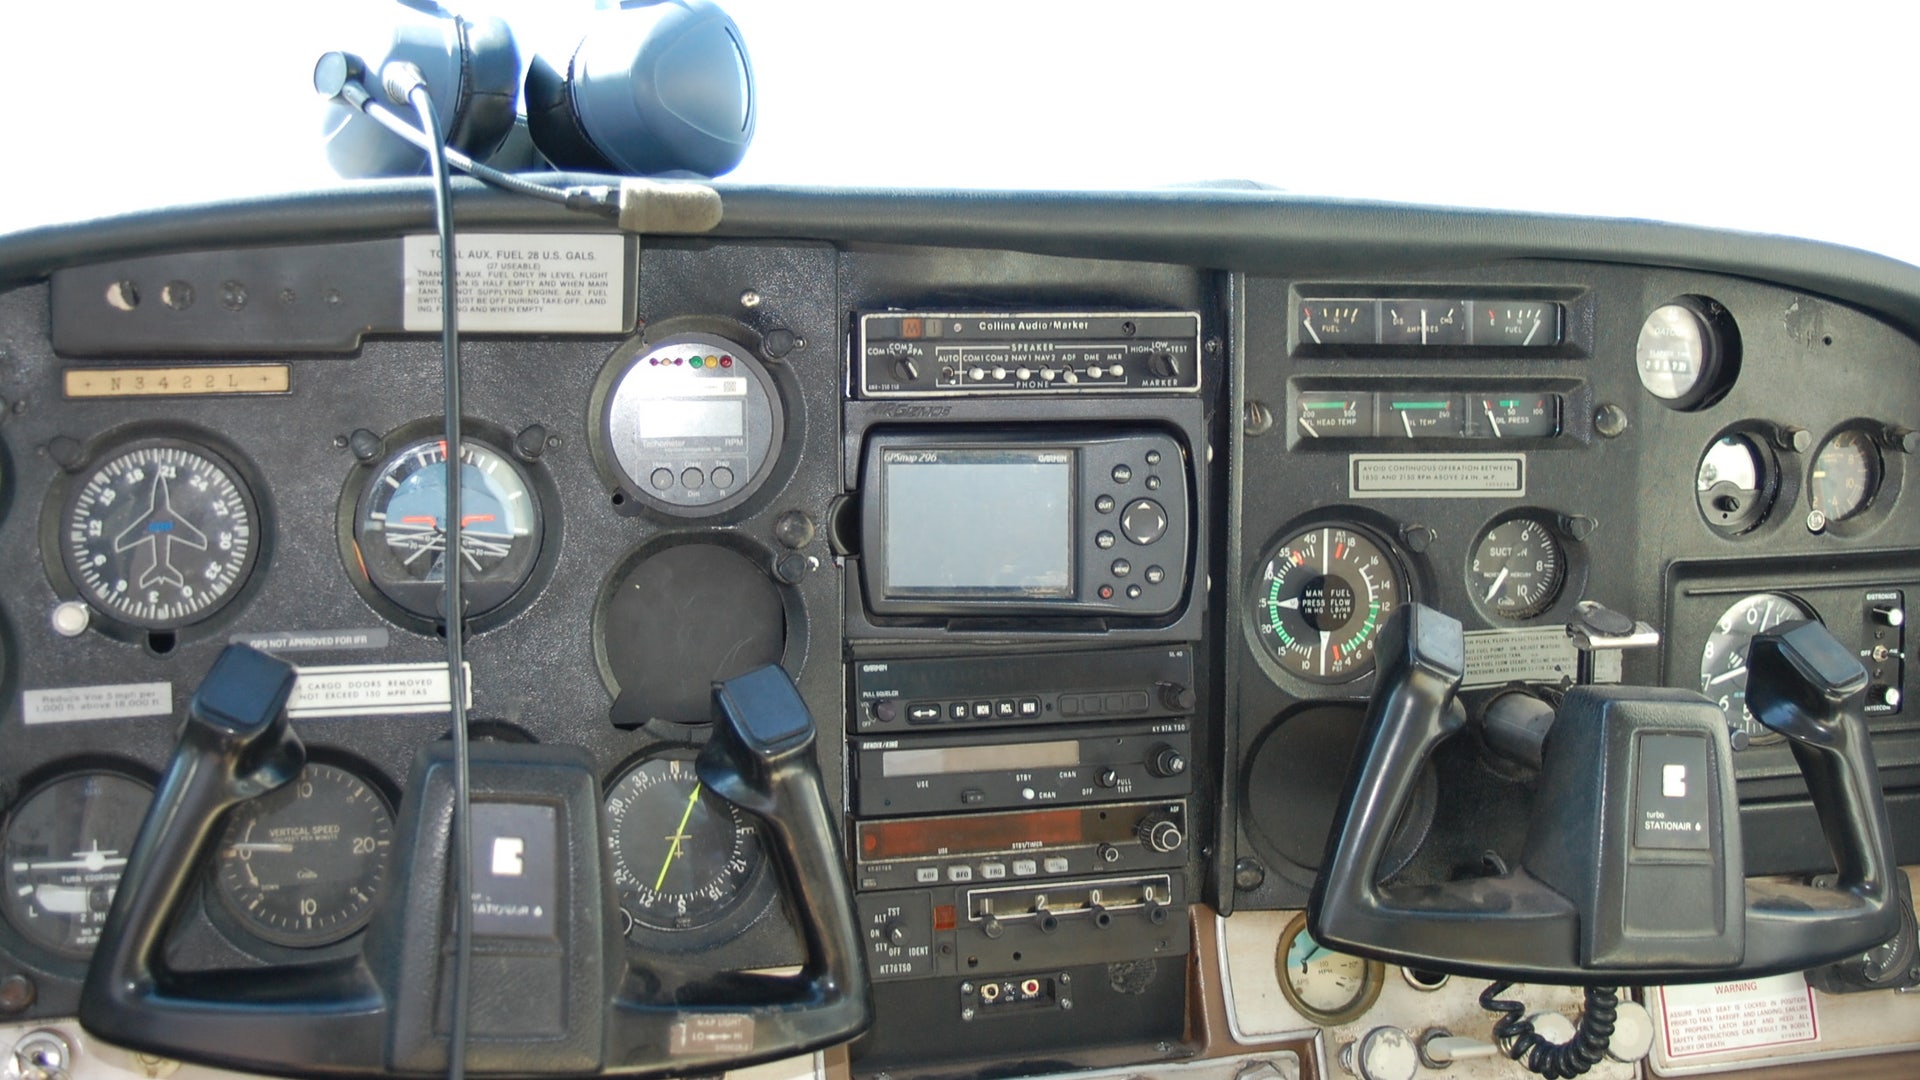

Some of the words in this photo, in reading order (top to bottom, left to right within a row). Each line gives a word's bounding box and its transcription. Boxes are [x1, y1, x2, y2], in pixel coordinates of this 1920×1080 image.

[430, 250, 463, 259] TOL
[468, 250, 492, 259] AUX.
[497, 250, 524, 259] FUEL
[528, 251, 540, 259] 28
[543, 251, 562, 260] U.S.
[566, 251, 596, 260] GALS.
[487, 262, 498, 270] (27
[501, 262, 540, 270] USEABLE)
[979, 320, 1015, 331] Collins
[1142, 379, 1178, 387] MARKER
[725, 438, 744, 446] RPM
[918, 453, 937, 462] 296
[126, 468, 144, 484] 18
[161, 466, 176, 478] 21
[189, 474, 208, 492] 24
[100, 488, 116, 506] 15
[212, 500, 228, 516] 27
[89, 519, 102, 537] 12
[220, 532, 232, 549] 30
[1304, 534, 1316, 544] 40
[1488, 531, 1496, 541] 4
[1522, 530, 1529, 541] 6
[1347, 538, 1356, 547] 18
[1279, 548, 1290, 558] 35
[1490, 548, 1527, 556] SUCTN
[1370, 556, 1378, 566] 16
[1473, 560, 1479, 571] 2
[1536, 561, 1543, 571] 8
[205, 561, 222, 580] 33
[1381, 580, 1390, 590] 14
[1518, 585, 1527, 596] 10
[1382, 602, 1390, 611] 12
[1746, 608, 1758, 625] 0
[1721, 619, 1731, 635] 9
[251, 640, 267, 649] GPS
[269, 639, 287, 648] NOT
[289, 637, 333, 647] APPROVED
[335, 636, 352, 645] FOR
[354, 635, 367, 644] IFR
[1367, 640, 1373, 649] 8
[1278, 647, 1286, 656] 15
[1356, 650, 1362, 659] 6
[1705, 642, 1714, 658] 8
[1302, 660, 1310, 670] 10
[1345, 656, 1351, 665] 4
[308, 682, 342, 690] CARGO
[348, 681, 382, 689] DOORS
[388, 679, 432, 687] REMOVED
[300, 692, 319, 700] NOT
[326, 690, 359, 699] EXCEED
[412, 688, 427, 696] IAS
[1001, 704, 1012, 713] RCL
[1023, 702, 1035, 712] MEM
[1719, 696, 1730, 712] 6
[977, 704, 990, 715] MON
[670, 761, 680, 774] N
[632, 771, 648, 788] 33
[1016, 773, 1032, 782] STBY
[1059, 771, 1076, 779] CHAN
[1039, 791, 1056, 799] CHAN
[609, 798, 623, 815] 30
[1646, 811, 1664, 819] turbo
[269, 827, 310, 836] VERTICAL
[312, 825, 340, 833] SPEED
[1645, 821, 1691, 831] STATIONAIR
[1695, 822, 1701, 831] 6
[353, 837, 375, 854] 20
[29, 906, 38, 917] L
[301, 898, 317, 915] 10
[888, 908, 900, 916] TST
[874, 914, 886, 923] ALT
[889, 948, 901, 956] OFF
[909, 947, 929, 956] IDENT
[1714, 981, 1758, 995] WARNING
[1670, 1010, 1692, 1018] ASSURE
[1744, 1001, 1766, 1009] LOCKED
